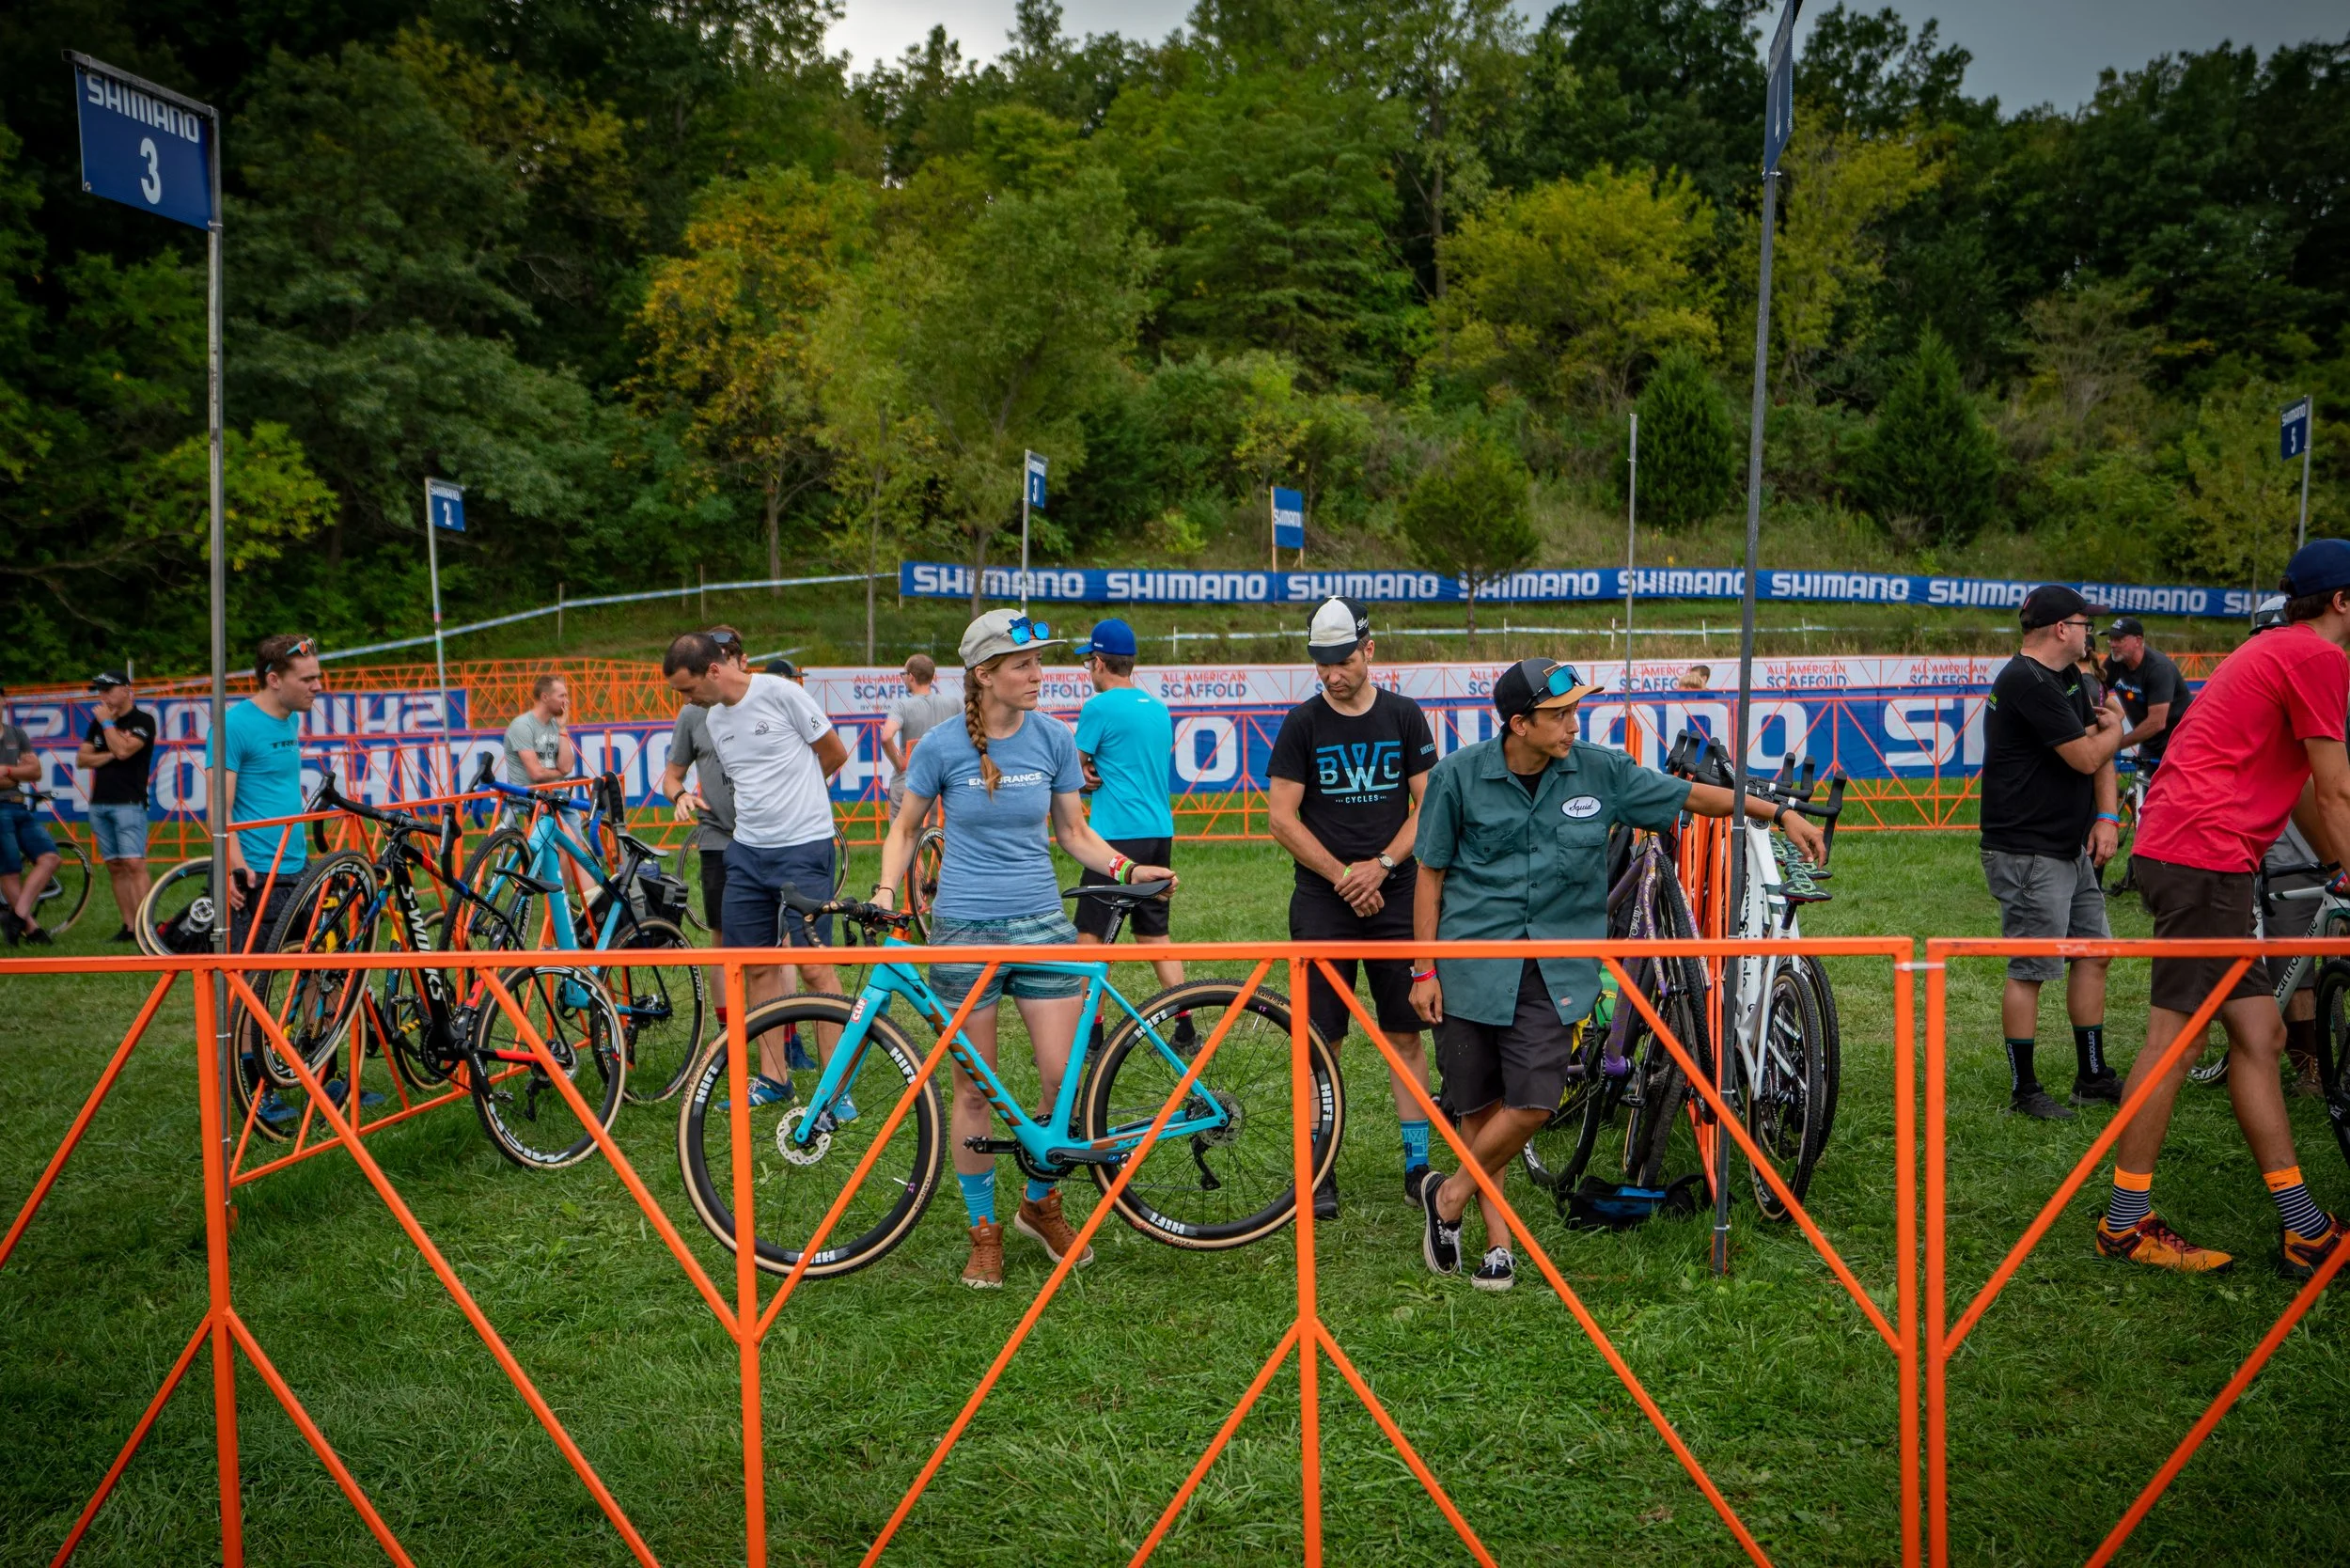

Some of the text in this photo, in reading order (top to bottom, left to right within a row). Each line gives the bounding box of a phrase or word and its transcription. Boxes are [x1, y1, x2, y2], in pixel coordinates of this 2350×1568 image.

[86, 73, 199, 143] SHIMANO
[140, 137, 162, 205] 3
[443, 501, 453, 526] 2
[913, 565, 1085, 598] SHIMANO
[1106, 572, 1267, 600] SHIMANO
[1288, 573, 1439, 600] SHIMANO
[1458, 572, 1599, 599] SHIMANO
[1772, 573, 1909, 602] SHIMANO
[1161, 672, 1246, 683] ALL-AMERICAN
[1620, 666, 1693, 677] ALL-AMERICA
[1767, 664, 1847, 675] ALL-AMERICAN
[1767, 675, 1847, 688] SCAFFOLD
[1910, 664, 1988, 674] ALL-AMERICAN
[1161, 683, 1247, 698] SCAFFOLD
[968, 772, 1042, 786] ENURANCE
[1316, 741, 1402, 794] BWC
[1345, 795, 1379, 804] CYCLES
[1568, 799, 1593, 816] Squid
[2088, 1030, 2099, 1074] cannondale
